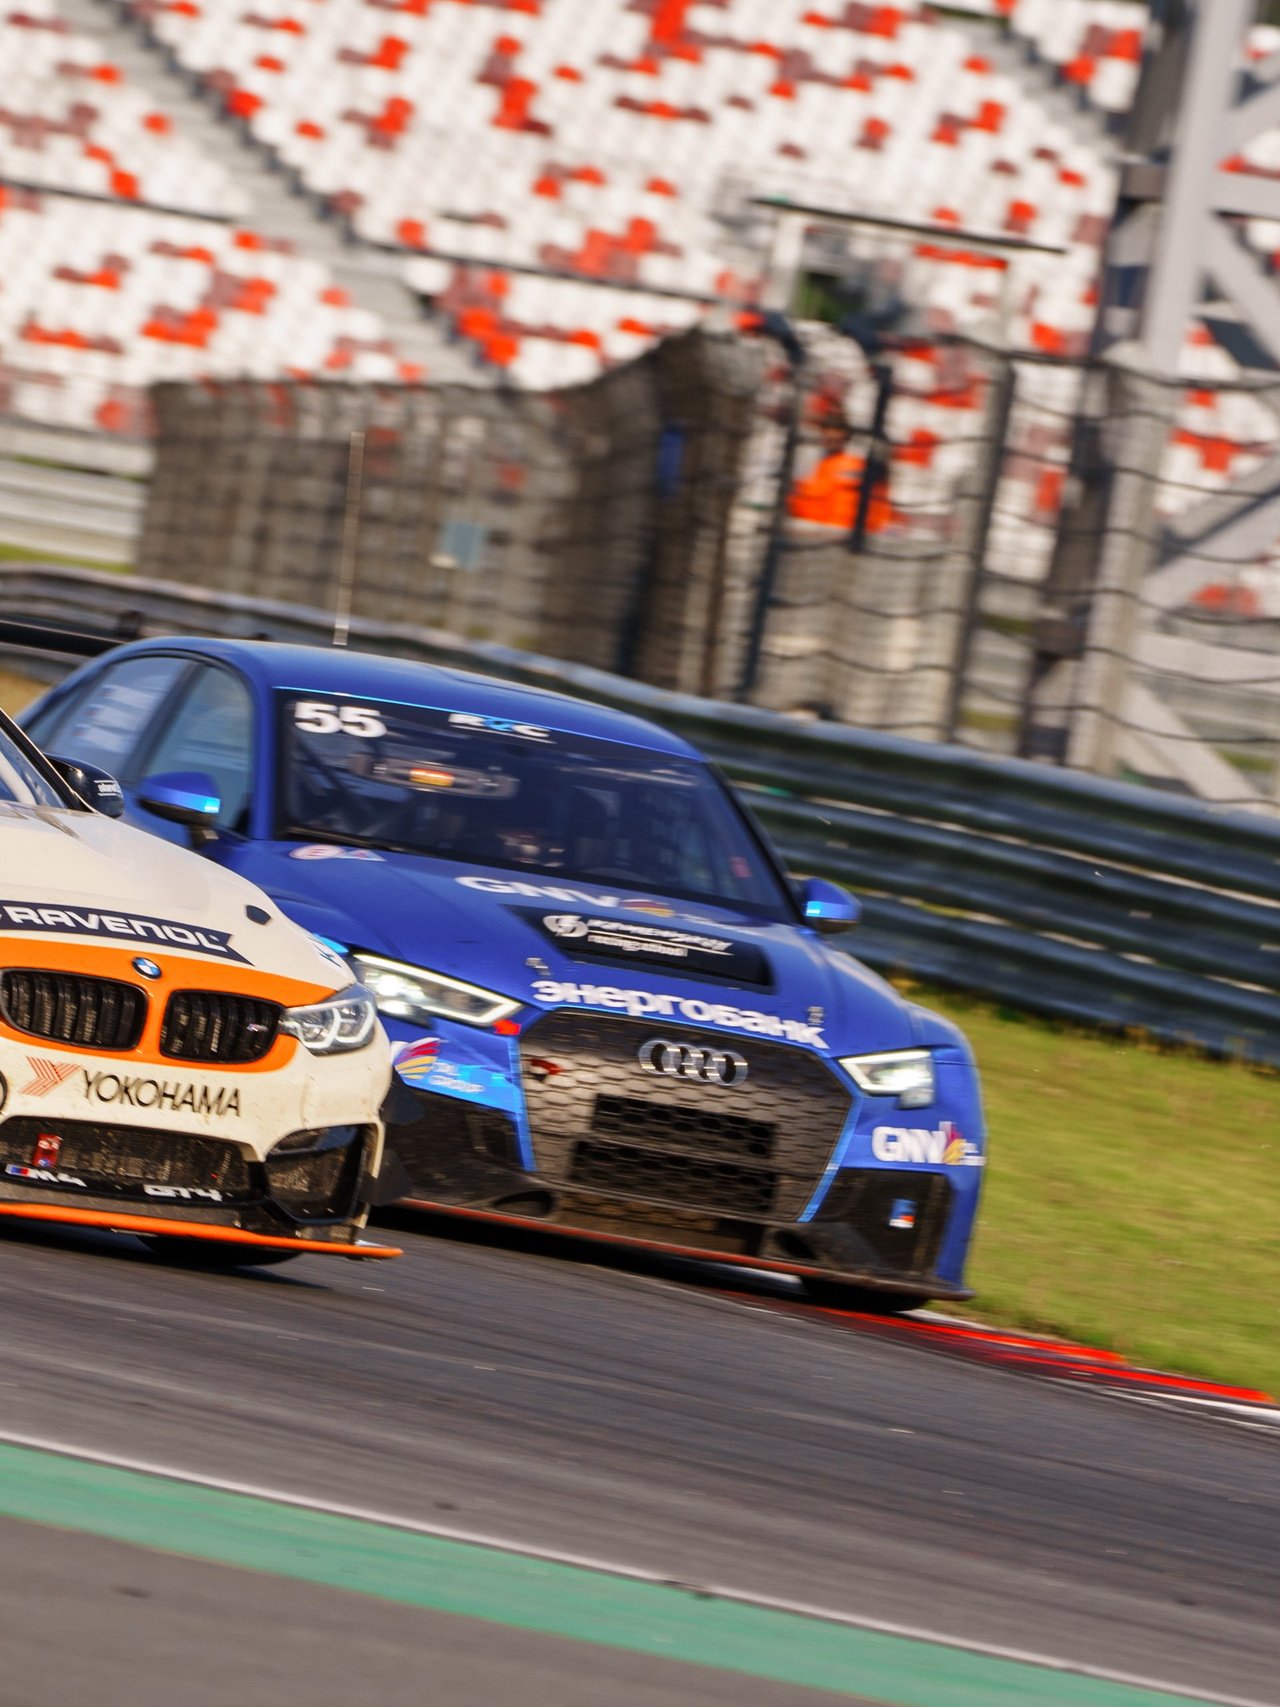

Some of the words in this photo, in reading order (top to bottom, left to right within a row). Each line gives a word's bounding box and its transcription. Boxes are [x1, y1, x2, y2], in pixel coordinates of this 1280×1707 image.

[294, 702, 388, 738] 55
[2, 905, 229, 953] RAVENOL
[82, 1069, 242, 1118] YOKOHAMA
